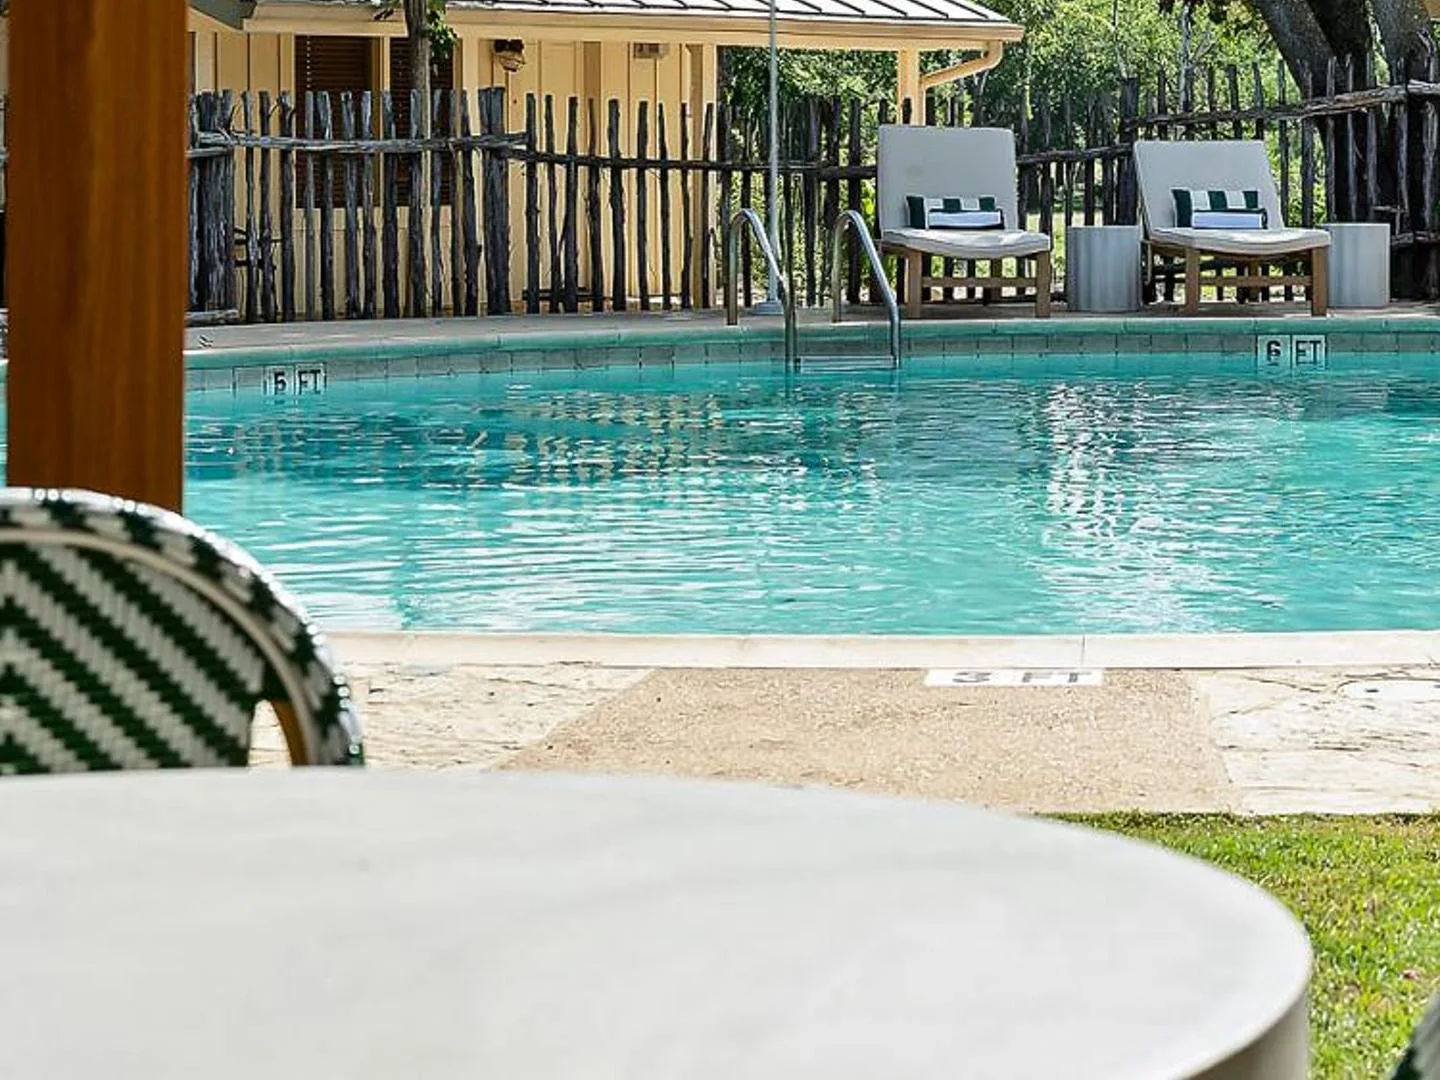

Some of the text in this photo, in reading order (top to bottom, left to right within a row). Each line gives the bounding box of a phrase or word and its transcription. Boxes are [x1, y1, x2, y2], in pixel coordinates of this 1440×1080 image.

[1267, 340, 1321, 364] 6 FT
[274, 369, 321, 394] 5 FT
[1021, 672, 1092, 683] FT
